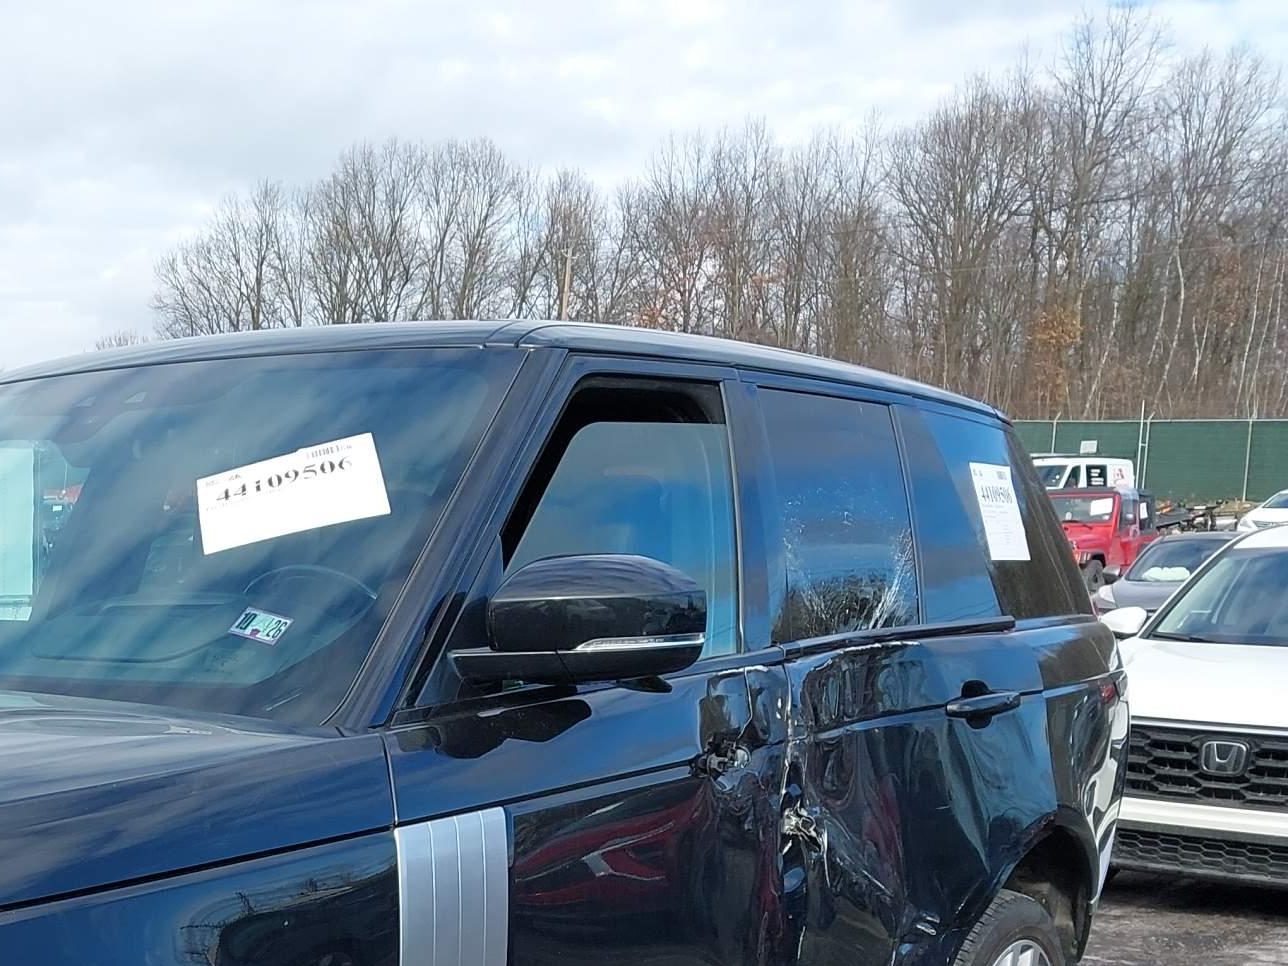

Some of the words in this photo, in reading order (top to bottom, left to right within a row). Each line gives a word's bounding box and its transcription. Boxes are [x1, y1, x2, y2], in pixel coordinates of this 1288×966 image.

[216, 456, 353, 502] 44109506
[235, 611, 258, 630] 10
[266, 619, 289, 639] 26
